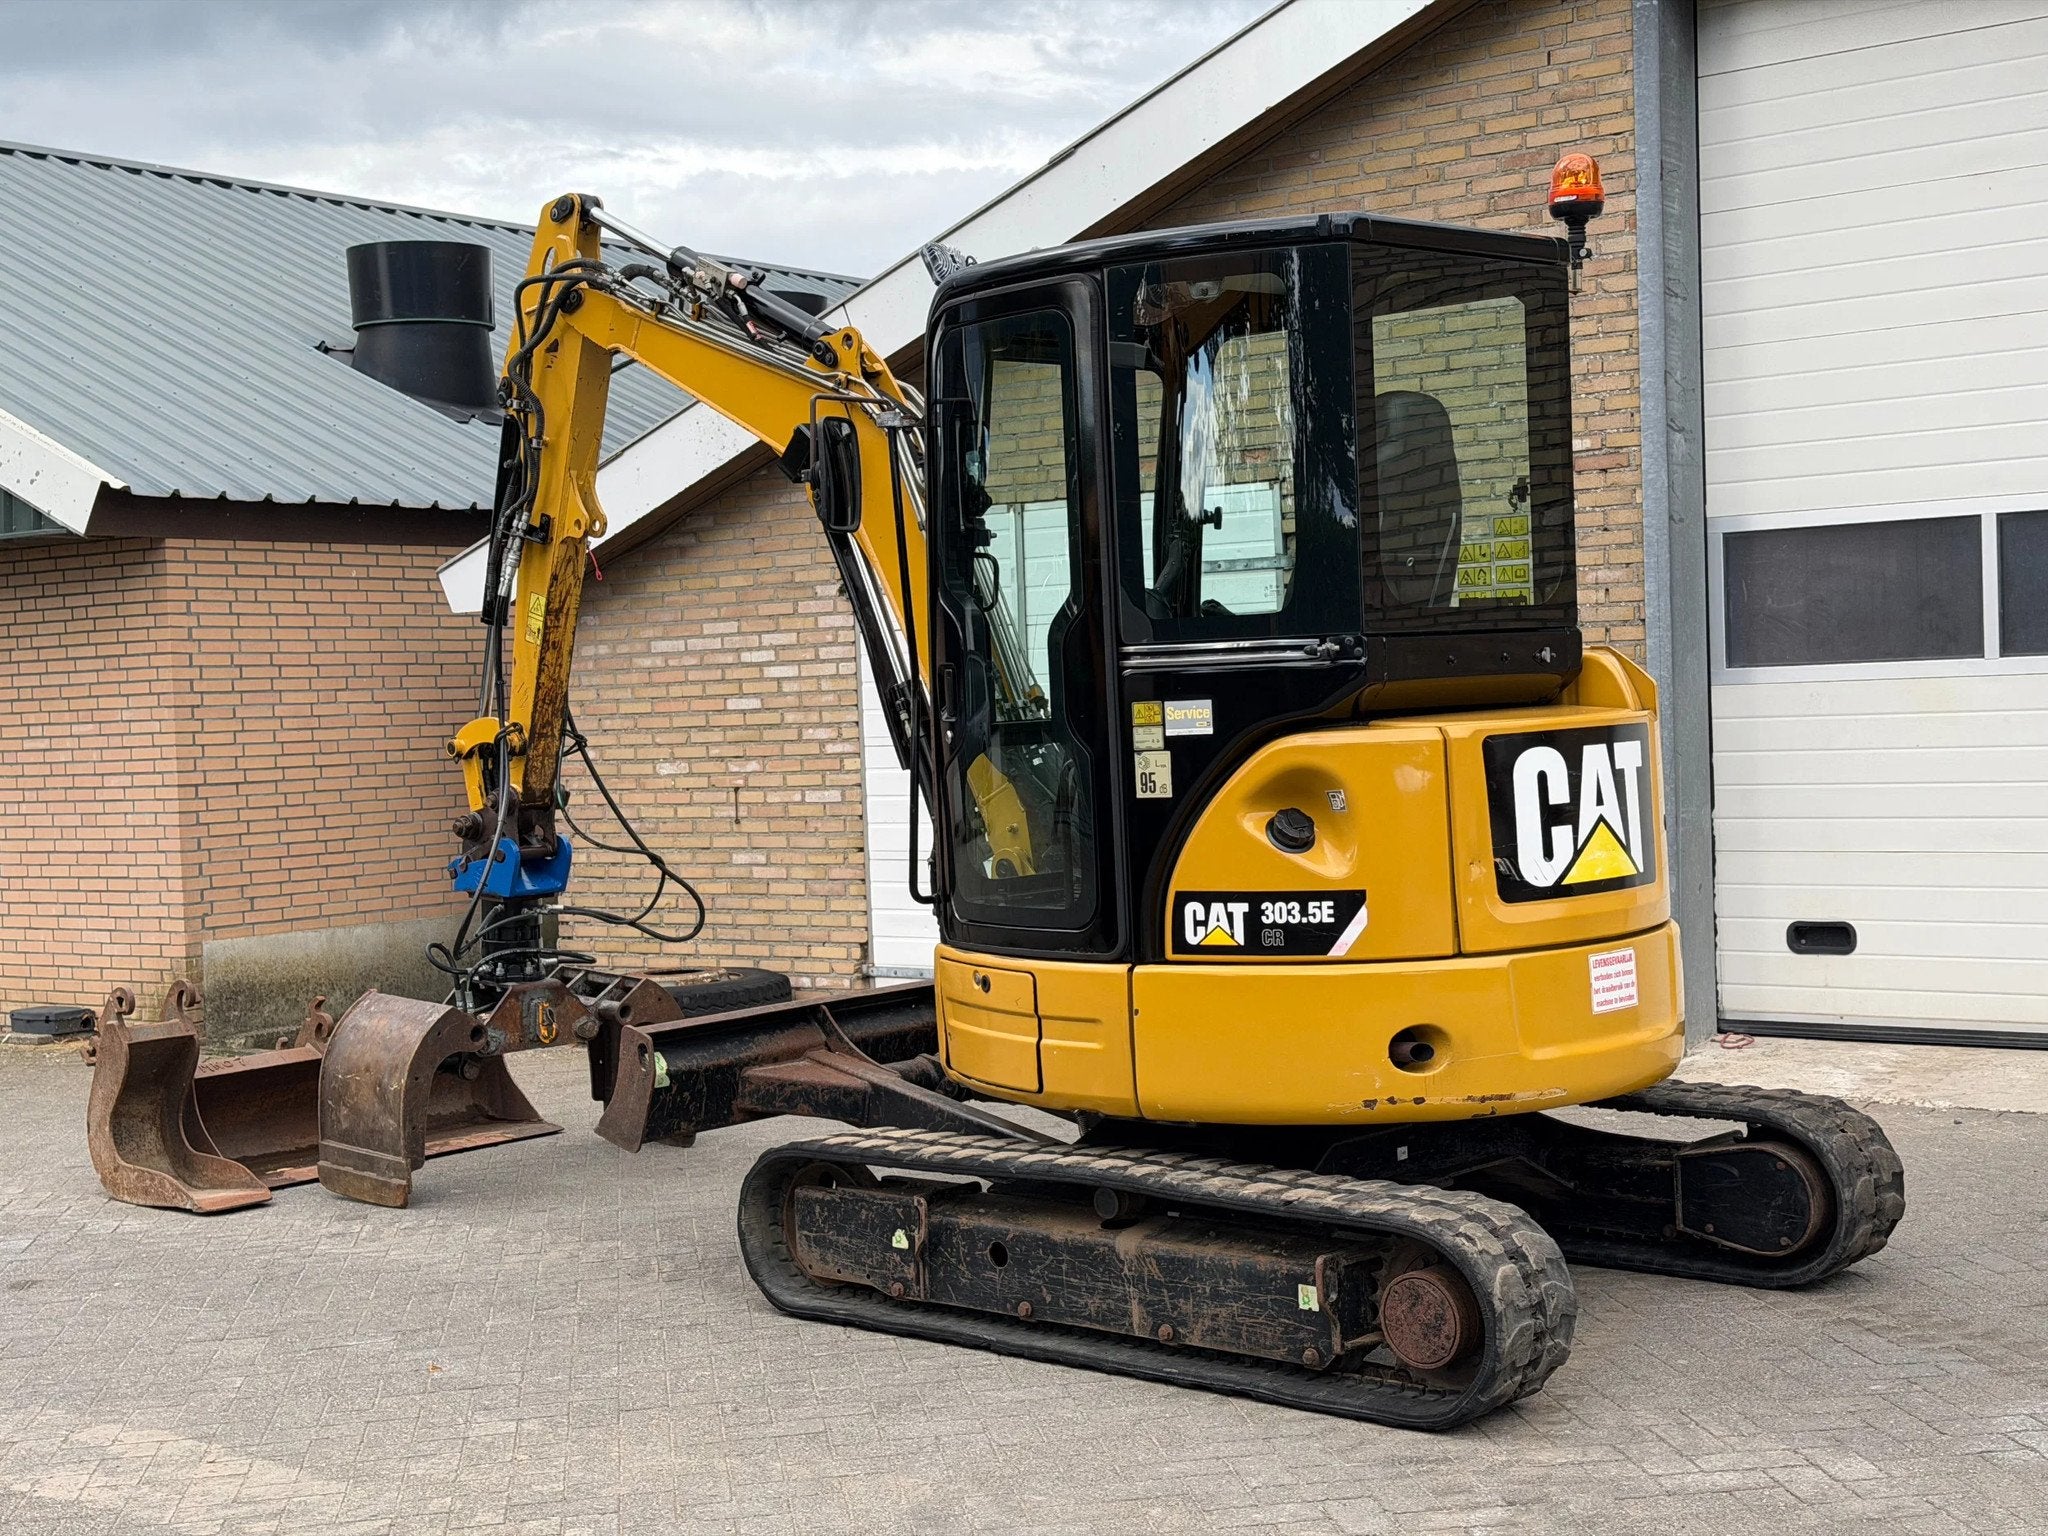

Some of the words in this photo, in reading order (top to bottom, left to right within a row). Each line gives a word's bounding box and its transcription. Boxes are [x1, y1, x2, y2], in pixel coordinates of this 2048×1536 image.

[1166, 705, 1210, 720] Service
[1140, 772, 1156, 794] 95
[1513, 740, 1644, 887] CAT
[1184, 901, 1249, 946] CAT
[1261, 901, 1335, 924] 303.5E
[1261, 929, 1285, 946] CR
